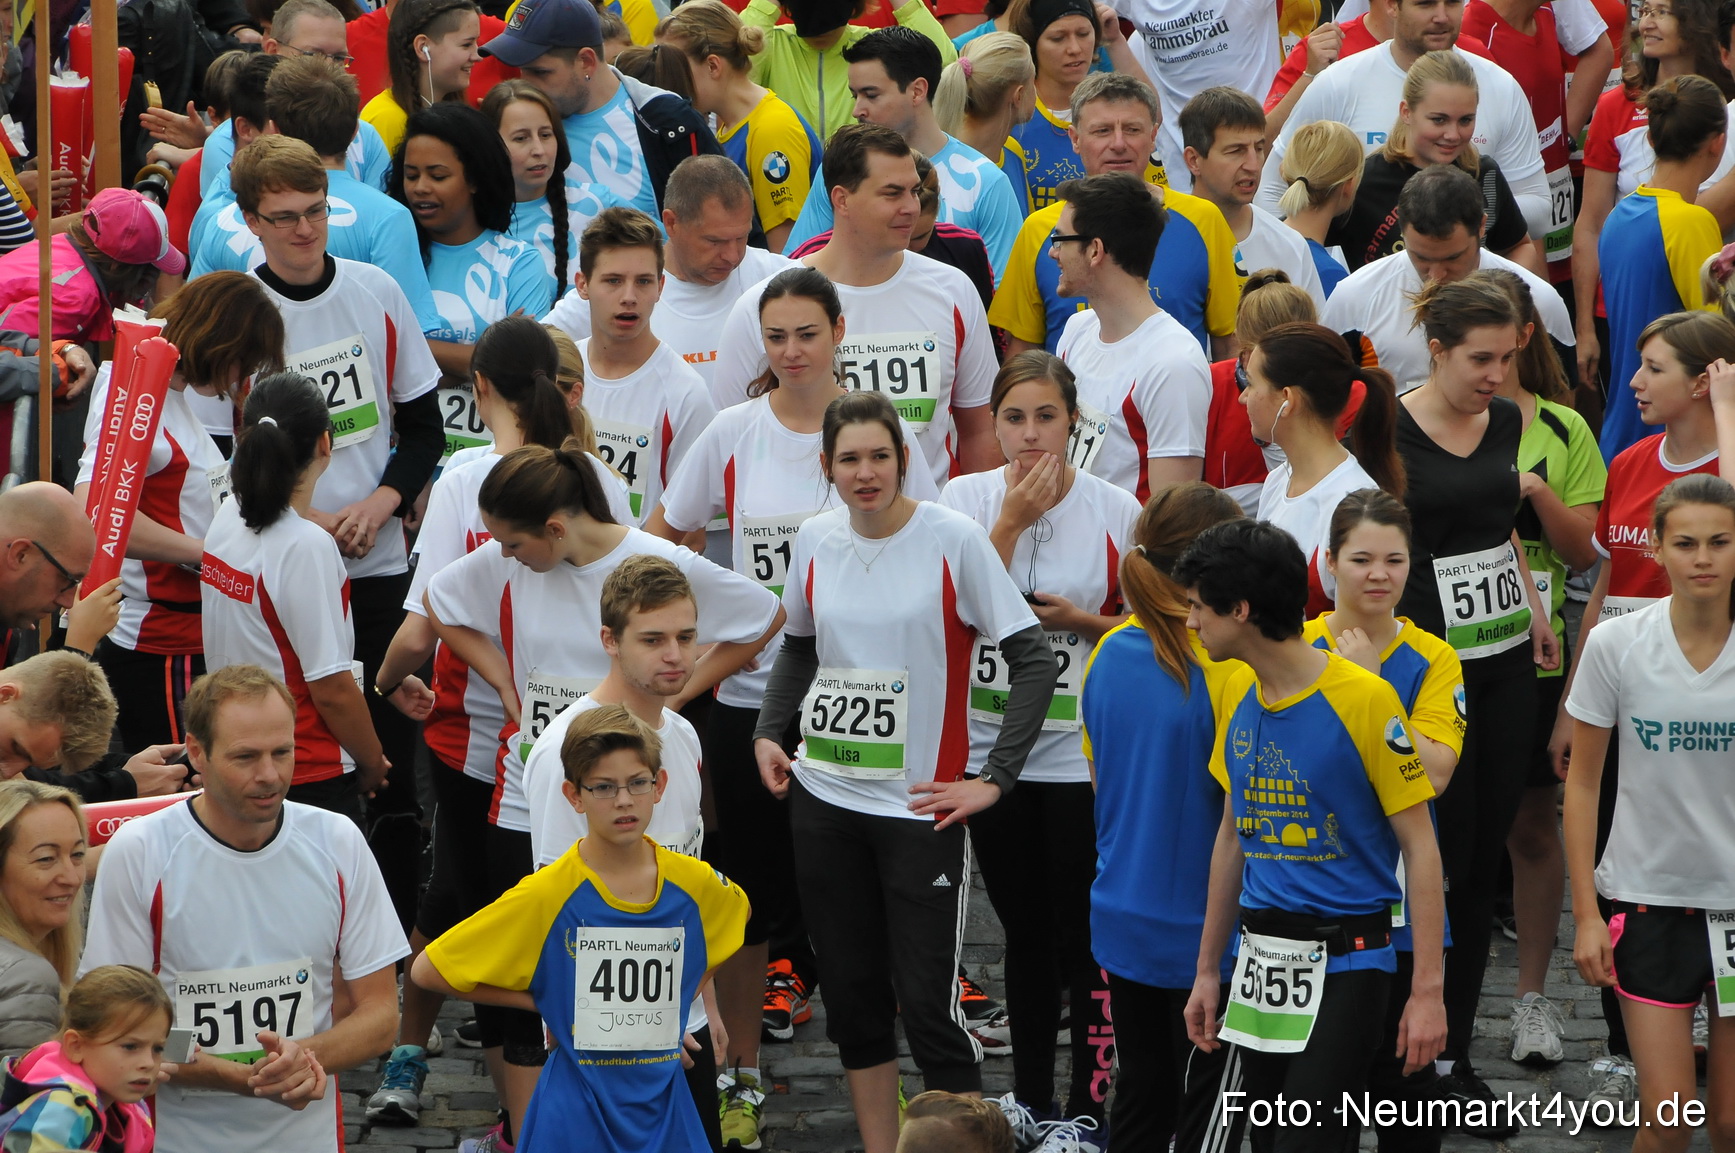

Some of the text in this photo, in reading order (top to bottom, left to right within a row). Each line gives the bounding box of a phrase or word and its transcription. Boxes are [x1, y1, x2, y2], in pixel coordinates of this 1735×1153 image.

[1145, 9, 1215, 33] Neumarkter
[867, 342, 919, 354] Neumarkt
[300, 350, 349, 375] Neumarkt
[840, 355, 928, 395] 5191
[102, 459, 138, 558] Audi BKK
[744, 526, 775, 538] PARTL
[1437, 563, 1475, 579] PARTL
[1451, 568, 1522, 620] 5108
[1476, 622, 1515, 643] Andrea
[527, 682, 557, 697] PARTL
[816, 678, 887, 693] PARTL Neumarkt
[811, 693, 895, 738] 5225
[834, 745, 861, 763] Lisa
[1669, 736, 1733, 752] POINT
[580, 939, 622, 951] PARTL
[1254, 946, 1304, 963] Neumarkt
[179, 974, 292, 996] PARTL Neumarkt
[589, 958, 674, 1003] 4001
[1241, 956, 1314, 1009] 5555
[193, 991, 302, 1049] 5197
[597, 1011, 663, 1033] JUSTUS
